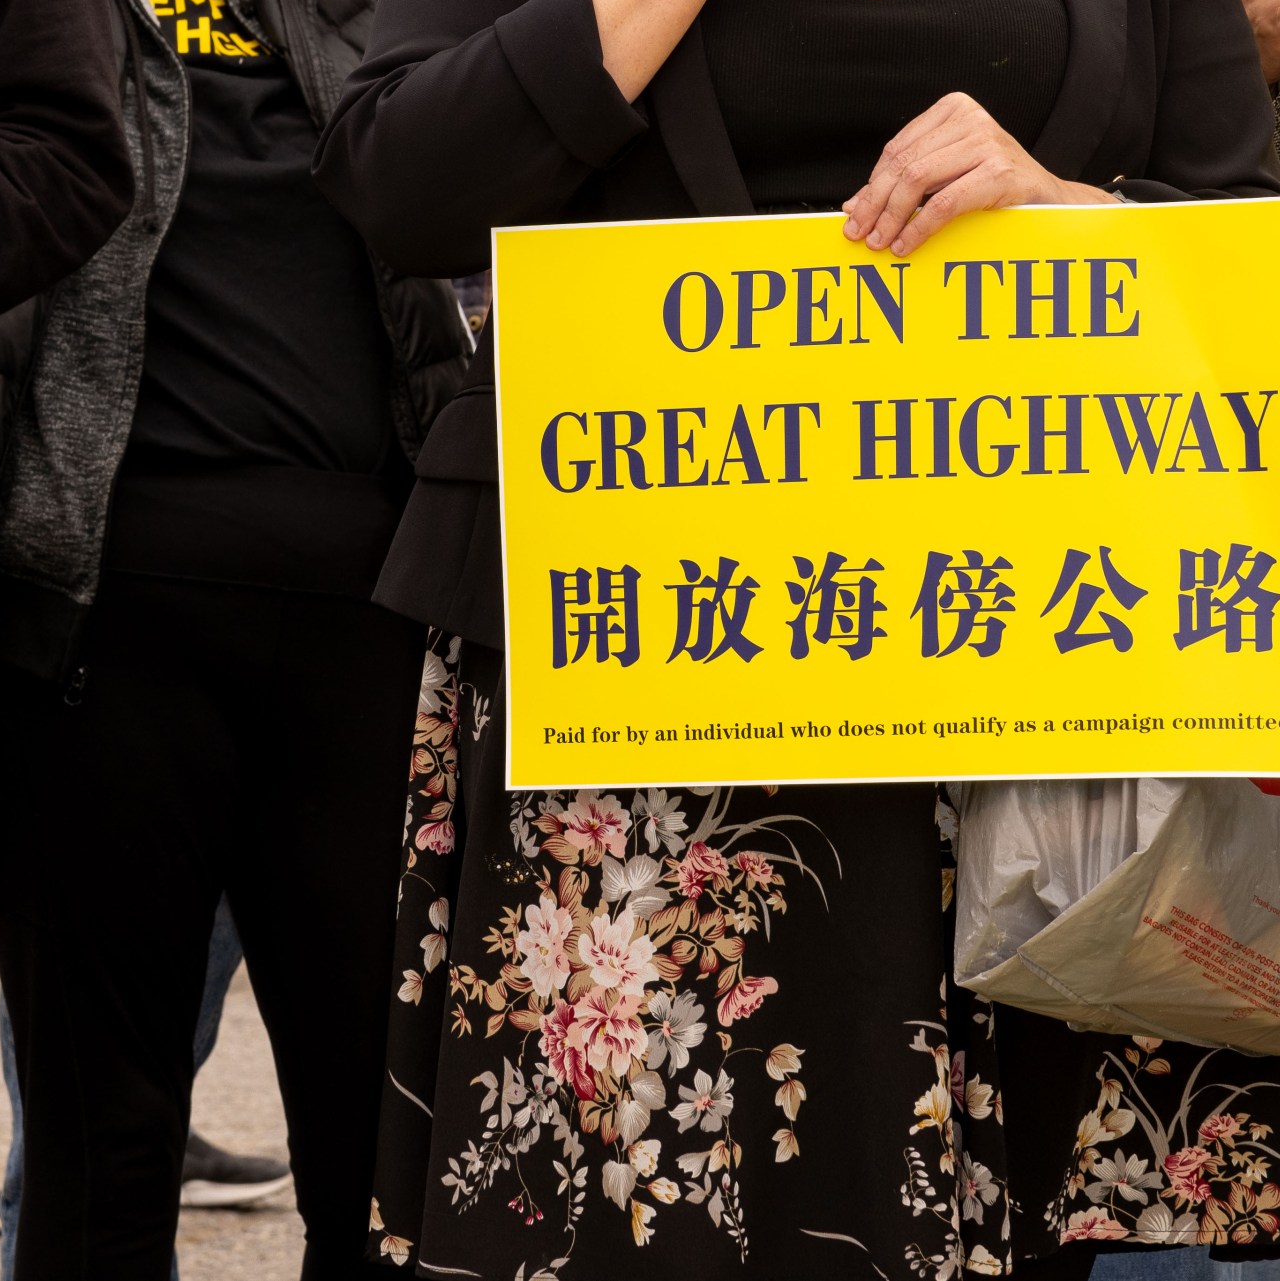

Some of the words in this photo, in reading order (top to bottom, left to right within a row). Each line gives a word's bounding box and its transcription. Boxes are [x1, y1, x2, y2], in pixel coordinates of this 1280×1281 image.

[663, 263, 910, 352] OPEN
[944, 259, 1139, 340] THE
[541, 403, 820, 493] GREAT
[852, 391, 1278, 480] HIGHWAY
[544, 727, 585, 744] Paid
[592, 727, 620, 743] for
[626, 726, 648, 745] by
[655, 730, 678, 741] an
[685, 722, 784, 740] individual
[790, 721, 831, 737] who
[838, 720, 885, 736] does
[892, 720, 926, 735] not
[934, 717, 1007, 738] qualify
[1014, 721, 1036, 732] as
[1044, 720, 1055, 732] a
[1063, 714, 1164, 734] campaign
[1143, 915, 1158, 928] BAG
[1171, 931, 1186, 944] NOT
[1184, 939, 1212, 959] CONTAIN
[1257, 979, 1269, 990] OR
[1169, 919, 1198, 939] REUSABLE
[1198, 935, 1211, 946] FOR
[1210, 942, 1219, 950] AT
[1218, 946, 1237, 960] LEAST
[1246, 962, 1262, 975] USES
[1261, 969, 1275, 982] AND
[1170, 906, 1186, 919] THIS
[1184, 913, 1200, 927] BAG
[1198, 921, 1233, 946] CONSISTS
[1231, 940, 1243, 952] OF
[1182, 948, 1204, 965] PLEASE
[1203, 960, 1227, 978] RETURN
